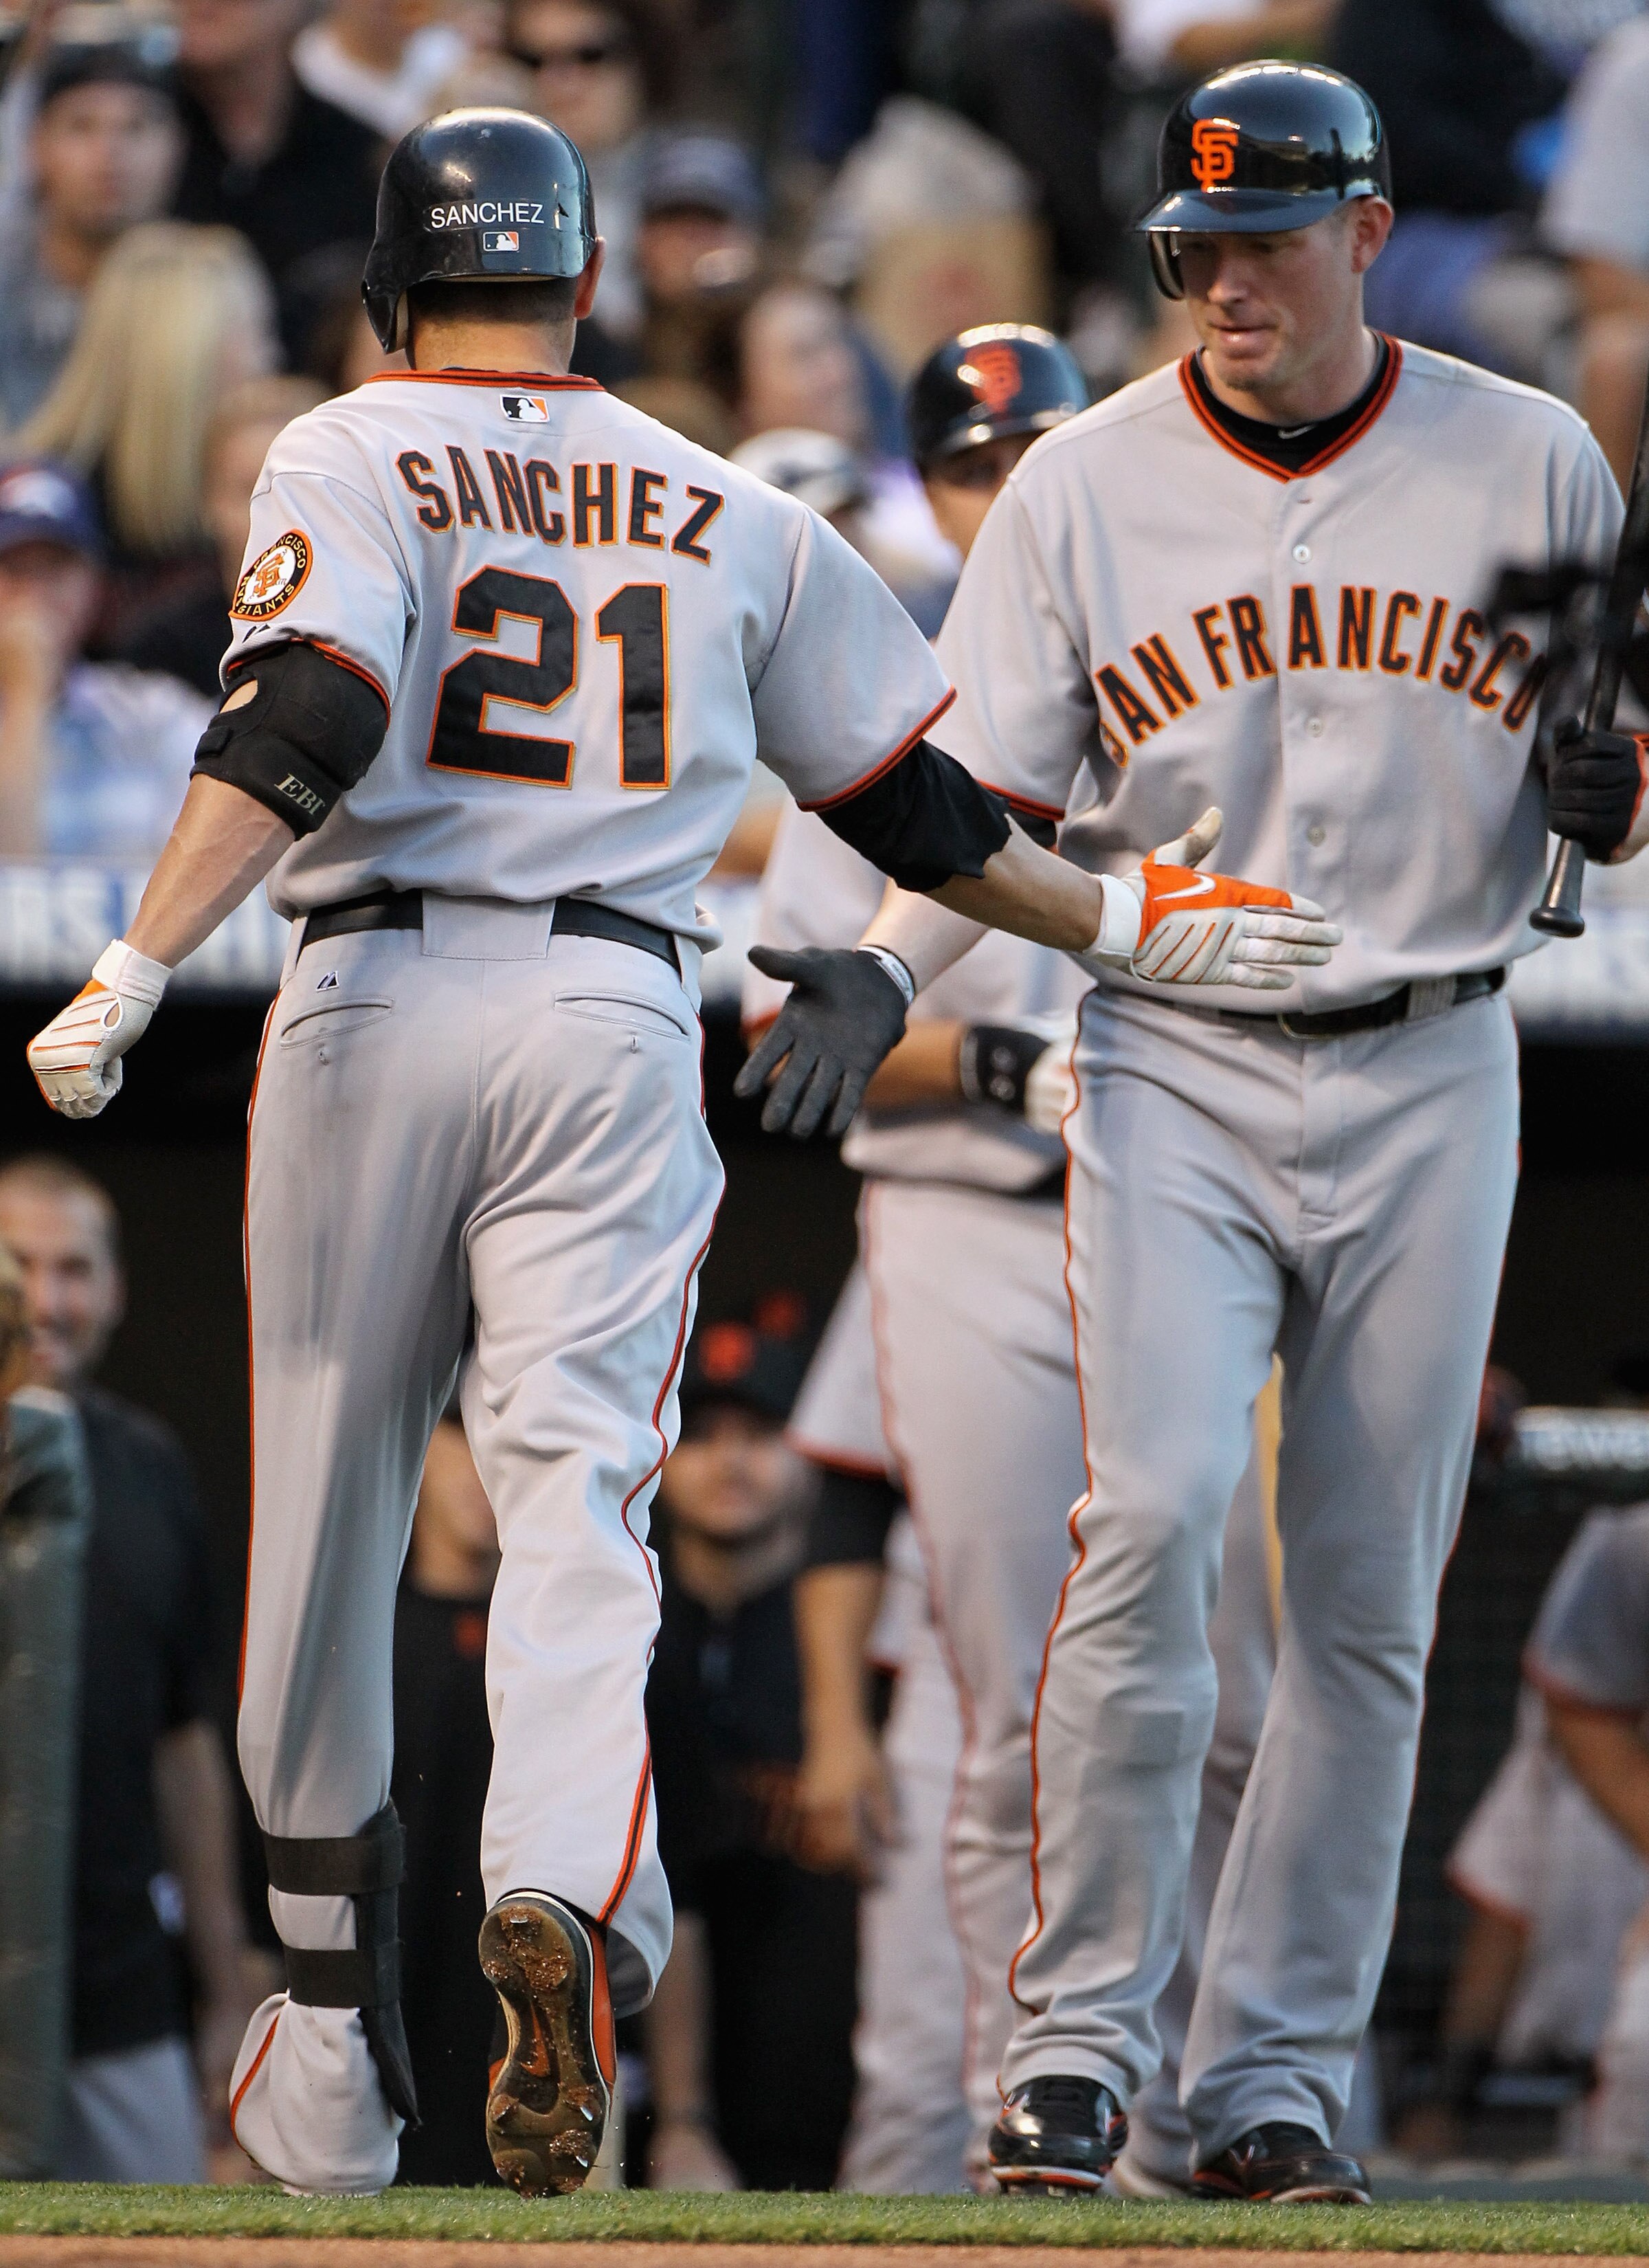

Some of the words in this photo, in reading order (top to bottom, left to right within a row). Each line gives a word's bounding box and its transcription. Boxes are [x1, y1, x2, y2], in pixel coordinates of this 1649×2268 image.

[1191, 118, 1239, 193] SF
[431, 202, 545, 229] SANCHEZ
[394, 444, 725, 567] SANCHEZ
[237, 583, 295, 616] GIANTS
[425, 564, 671, 790] 21
[1191, 583, 1547, 733] FRANCISCO
[274, 773, 326, 815] EBI
